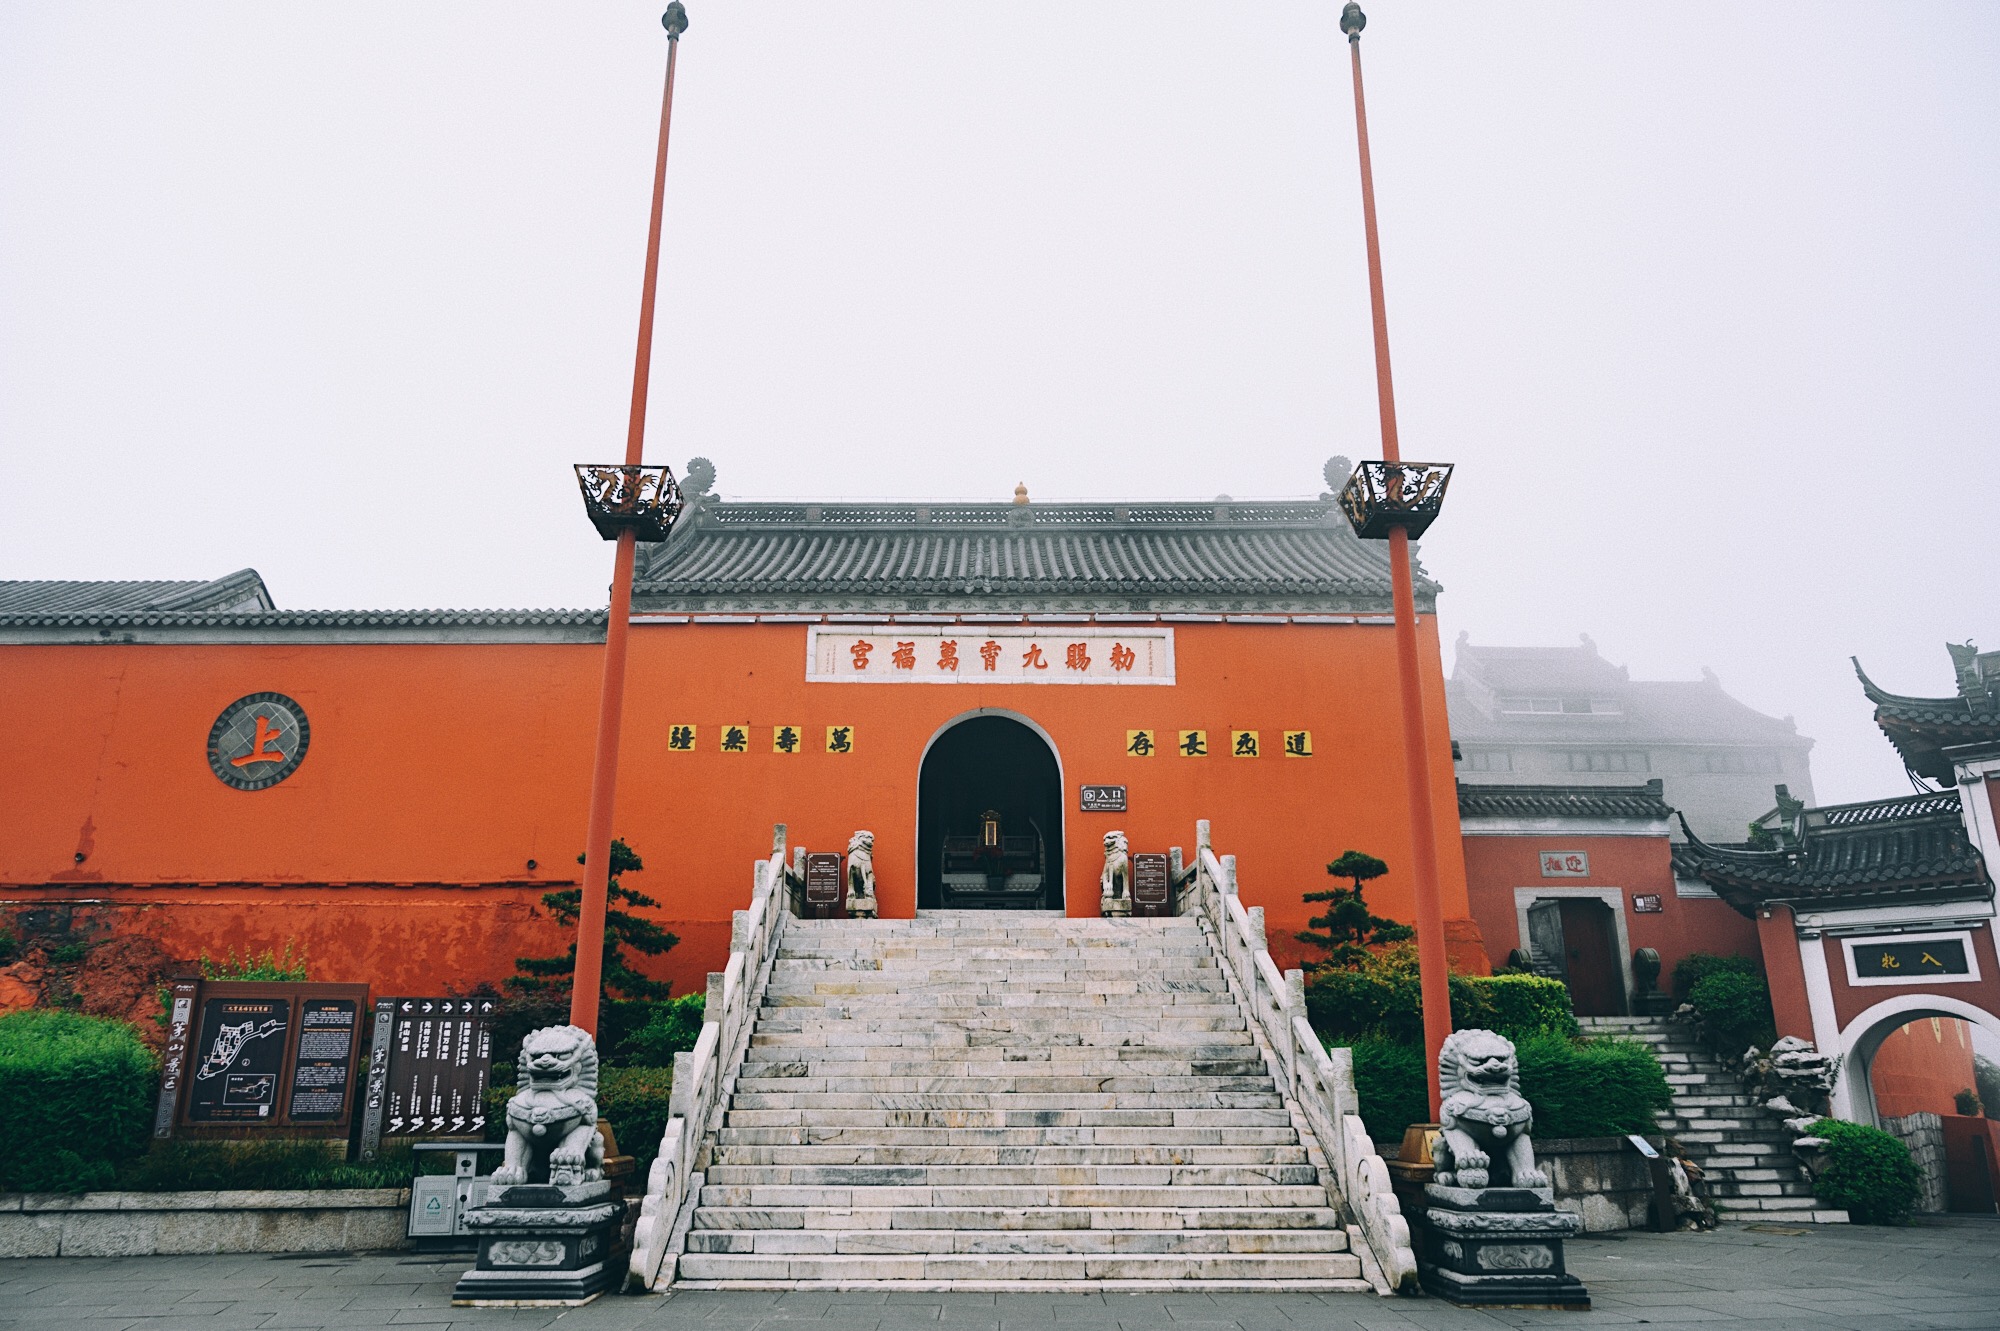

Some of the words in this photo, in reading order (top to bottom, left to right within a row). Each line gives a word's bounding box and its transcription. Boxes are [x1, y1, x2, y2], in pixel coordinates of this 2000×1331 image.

[230, 715, 285, 768] 上
[1098, 789, 1121, 799] 入口
[164, 1022, 185, 1089] 茅山景区
[369, 1047, 386, 1108] 茅山景区
